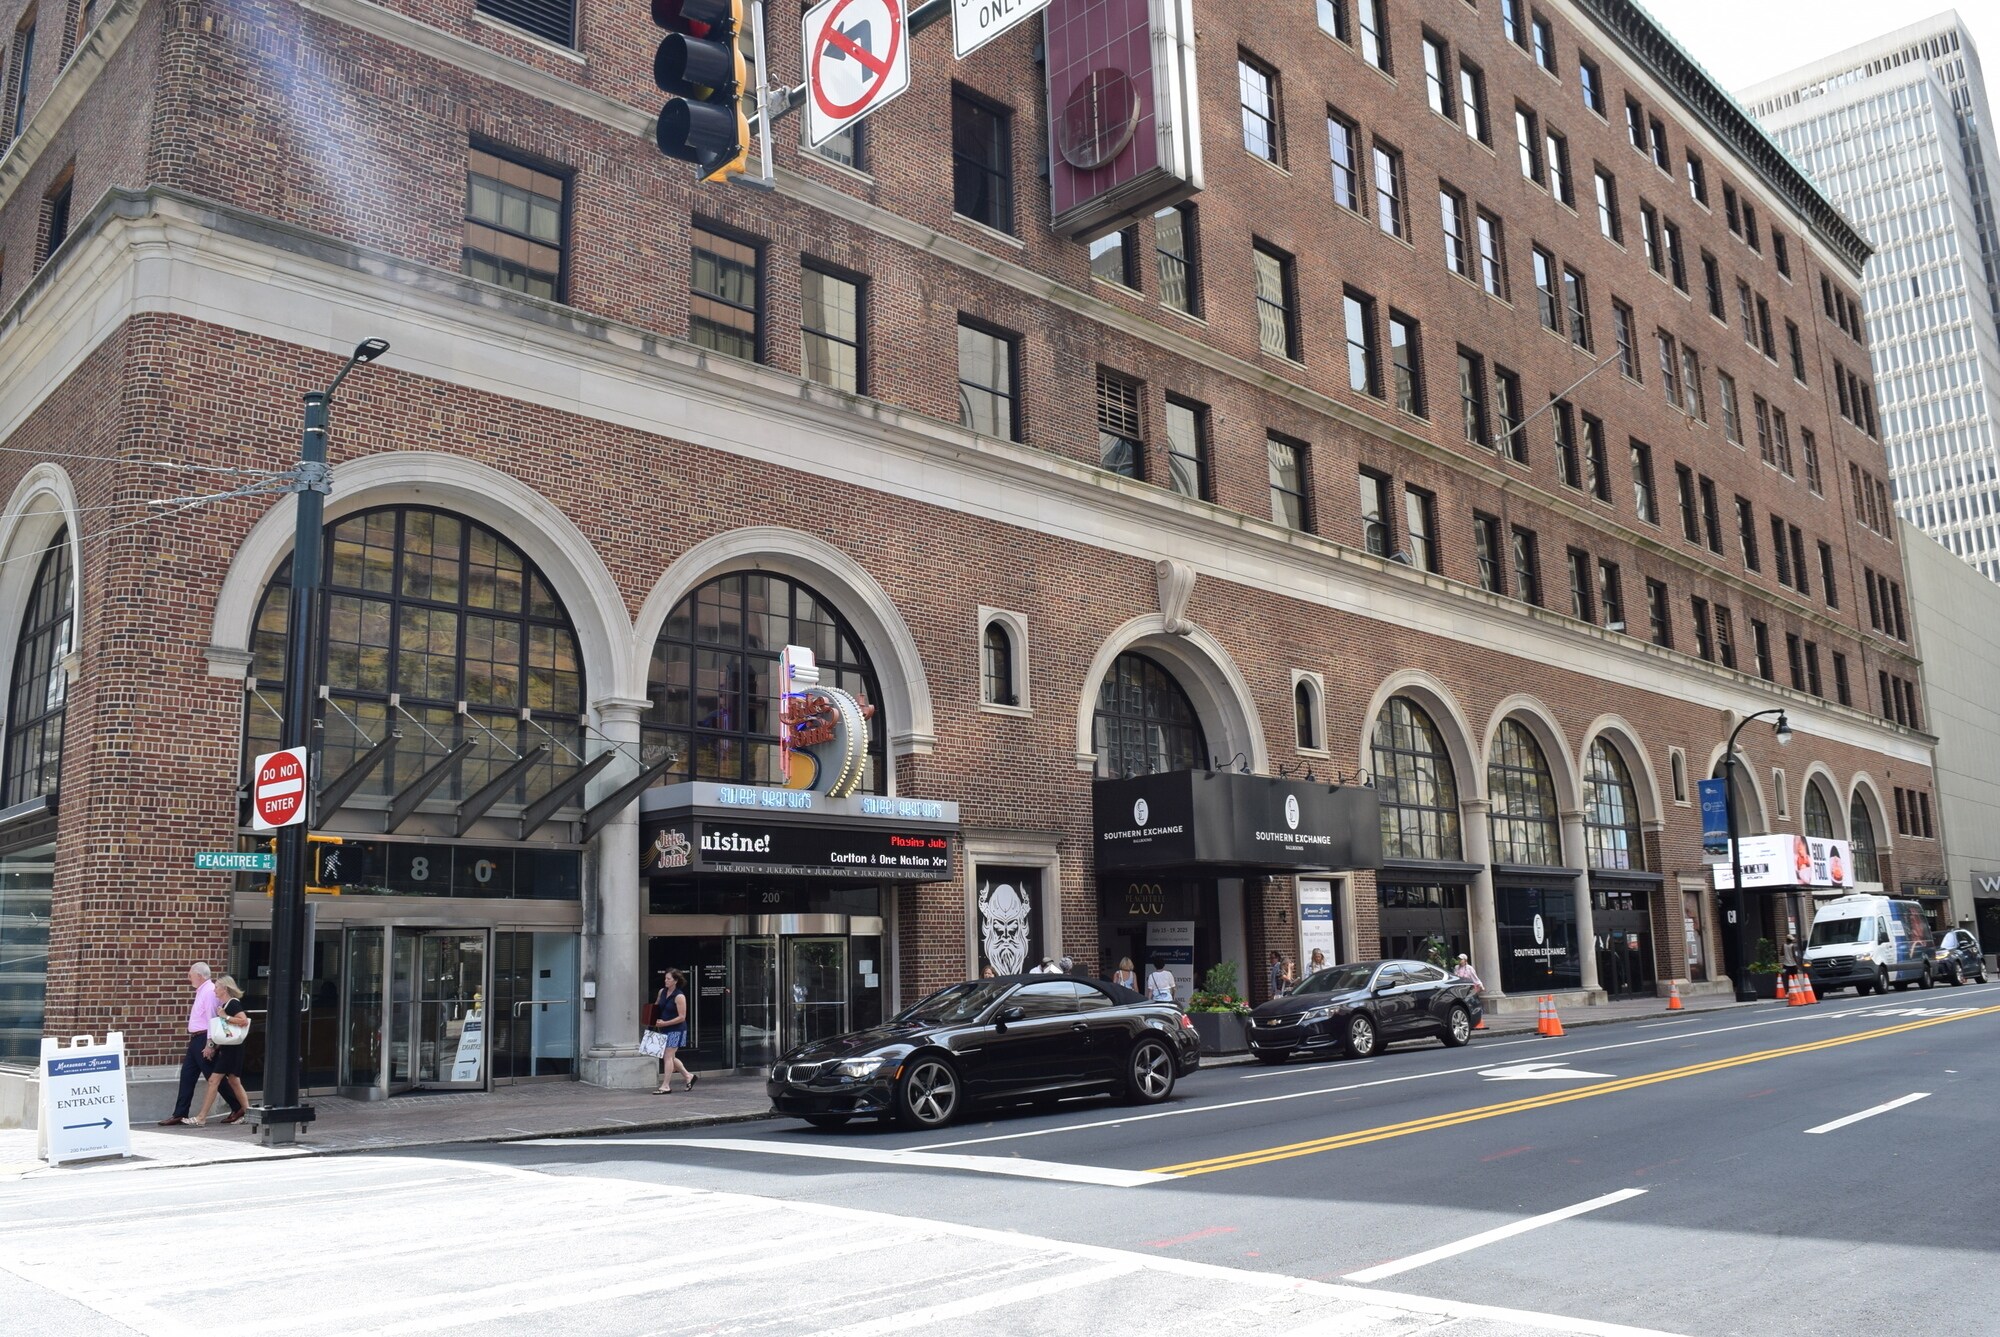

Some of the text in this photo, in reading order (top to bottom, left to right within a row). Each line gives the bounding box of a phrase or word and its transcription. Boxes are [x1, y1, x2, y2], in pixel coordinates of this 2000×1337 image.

[980, 0, 1021, 28] ONL
[263, 763, 298, 781] DO NOT
[265, 797, 294, 813] ENTER
[658, 829, 686, 848] Juke
[1104, 825, 1183, 840] SOUTHERN EXCHANGE
[1256, 831, 1332, 845] SOUTHERN EXCHANGE
[891, 836, 947, 849] Playing July
[198, 854, 258, 868] PEACHTREE
[262, 861, 271, 869] NE
[658, 850, 688, 869] Joint
[831, 852, 867, 864] Carlton
[871, 854, 877, 864] &
[880, 854, 897, 865] One
[900, 855, 930, 866] Nation
[715, 865, 734, 873] JUKE
[766, 866, 804, 875] JUKE JOINT
[815, 868, 832, 876] JUKE
[904, 871, 921, 879] JUKE
[762, 892, 780, 903] 200
[1128, 883, 1163, 915] 200
[1513, 947, 1567, 957] SOUTHERN EXCHANGE
[71, 1085, 100, 1096] MAIN
[57, 1095, 115, 1109] ENTRANCE
